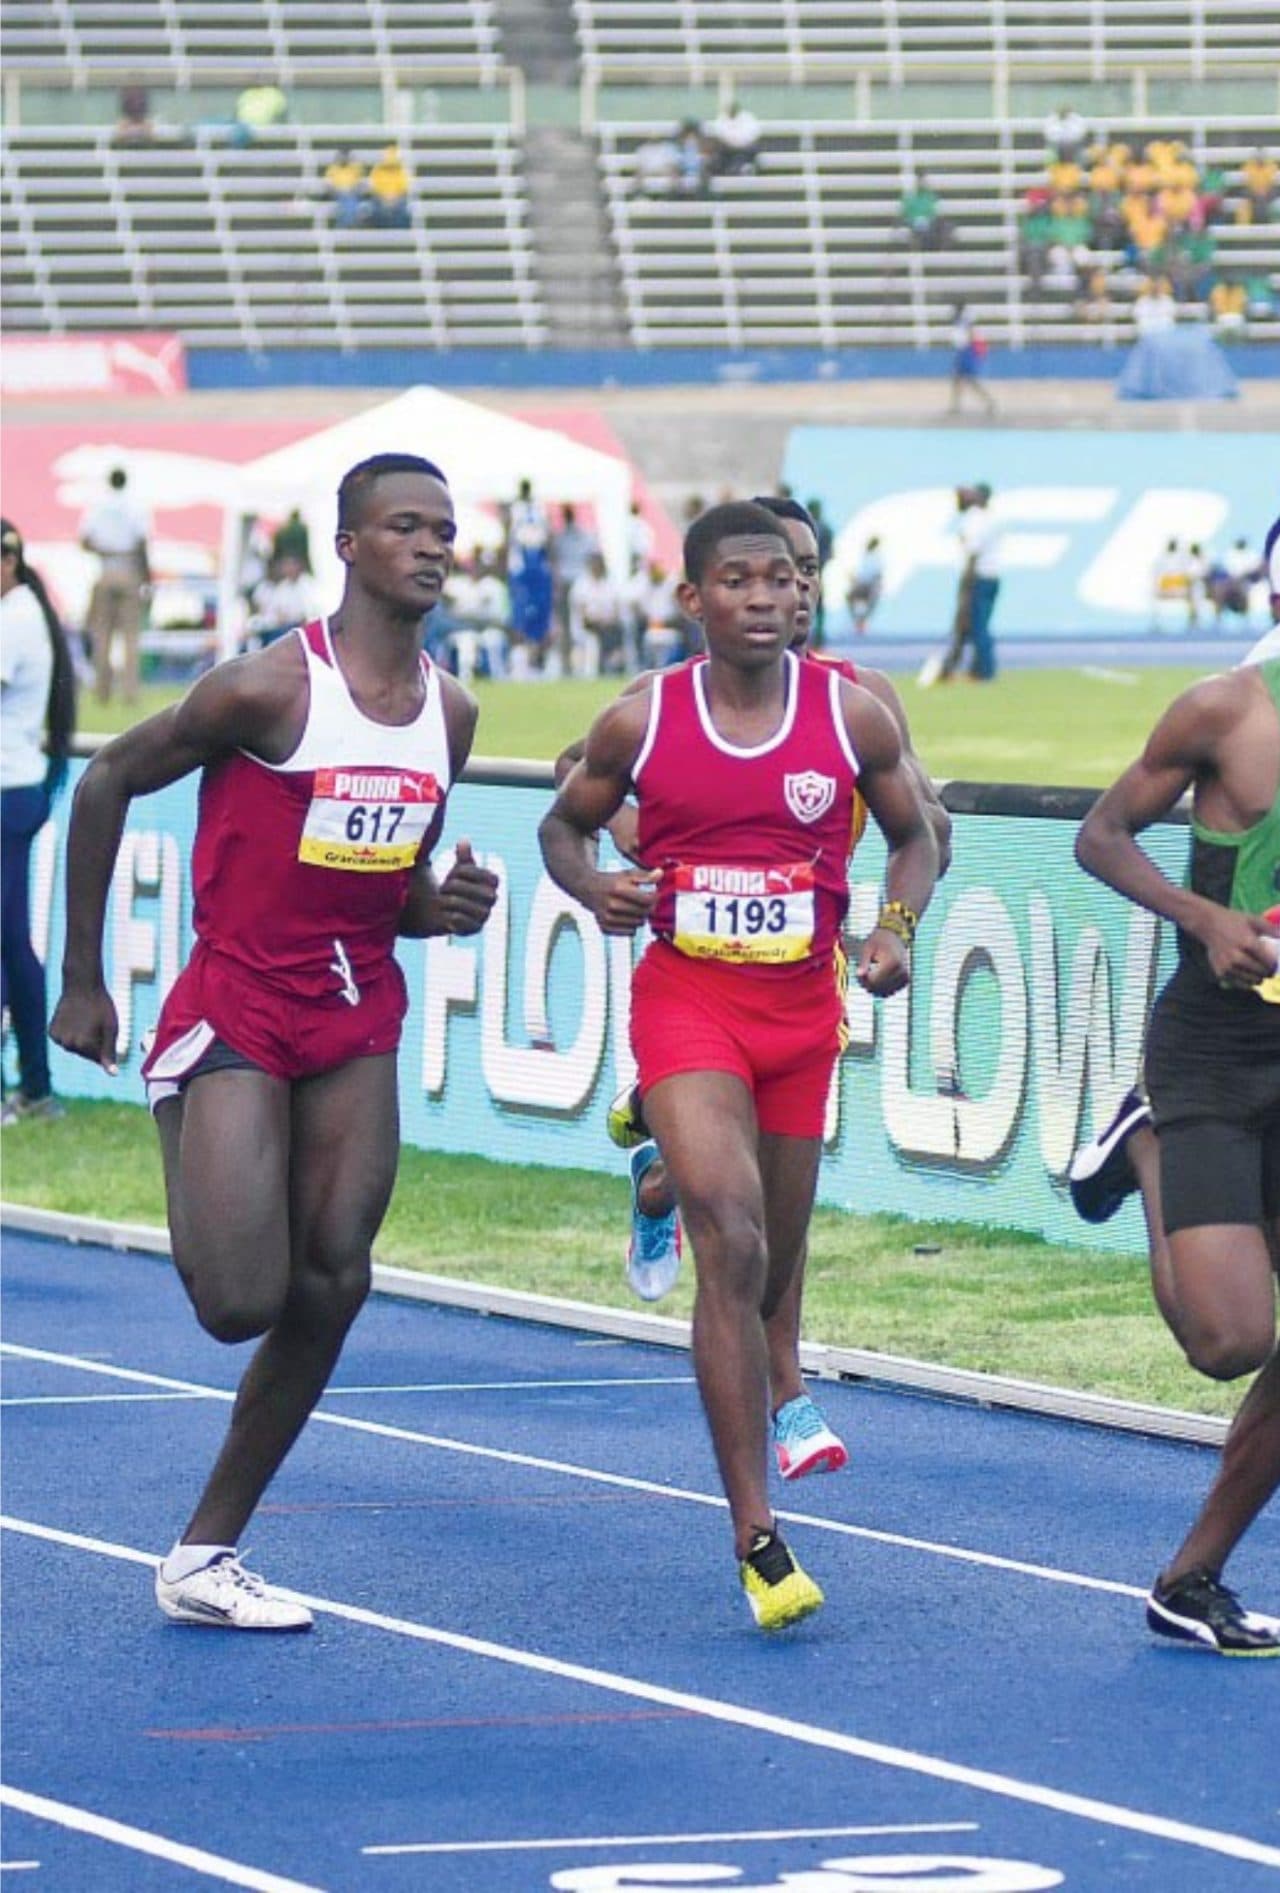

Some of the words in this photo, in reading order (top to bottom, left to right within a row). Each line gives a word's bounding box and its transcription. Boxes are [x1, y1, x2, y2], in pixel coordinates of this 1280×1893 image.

[334, 772, 401, 801] PUMA
[346, 805, 405, 843] 617
[693, 866, 766, 895] PUMA
[704, 897, 786, 935] 1193
